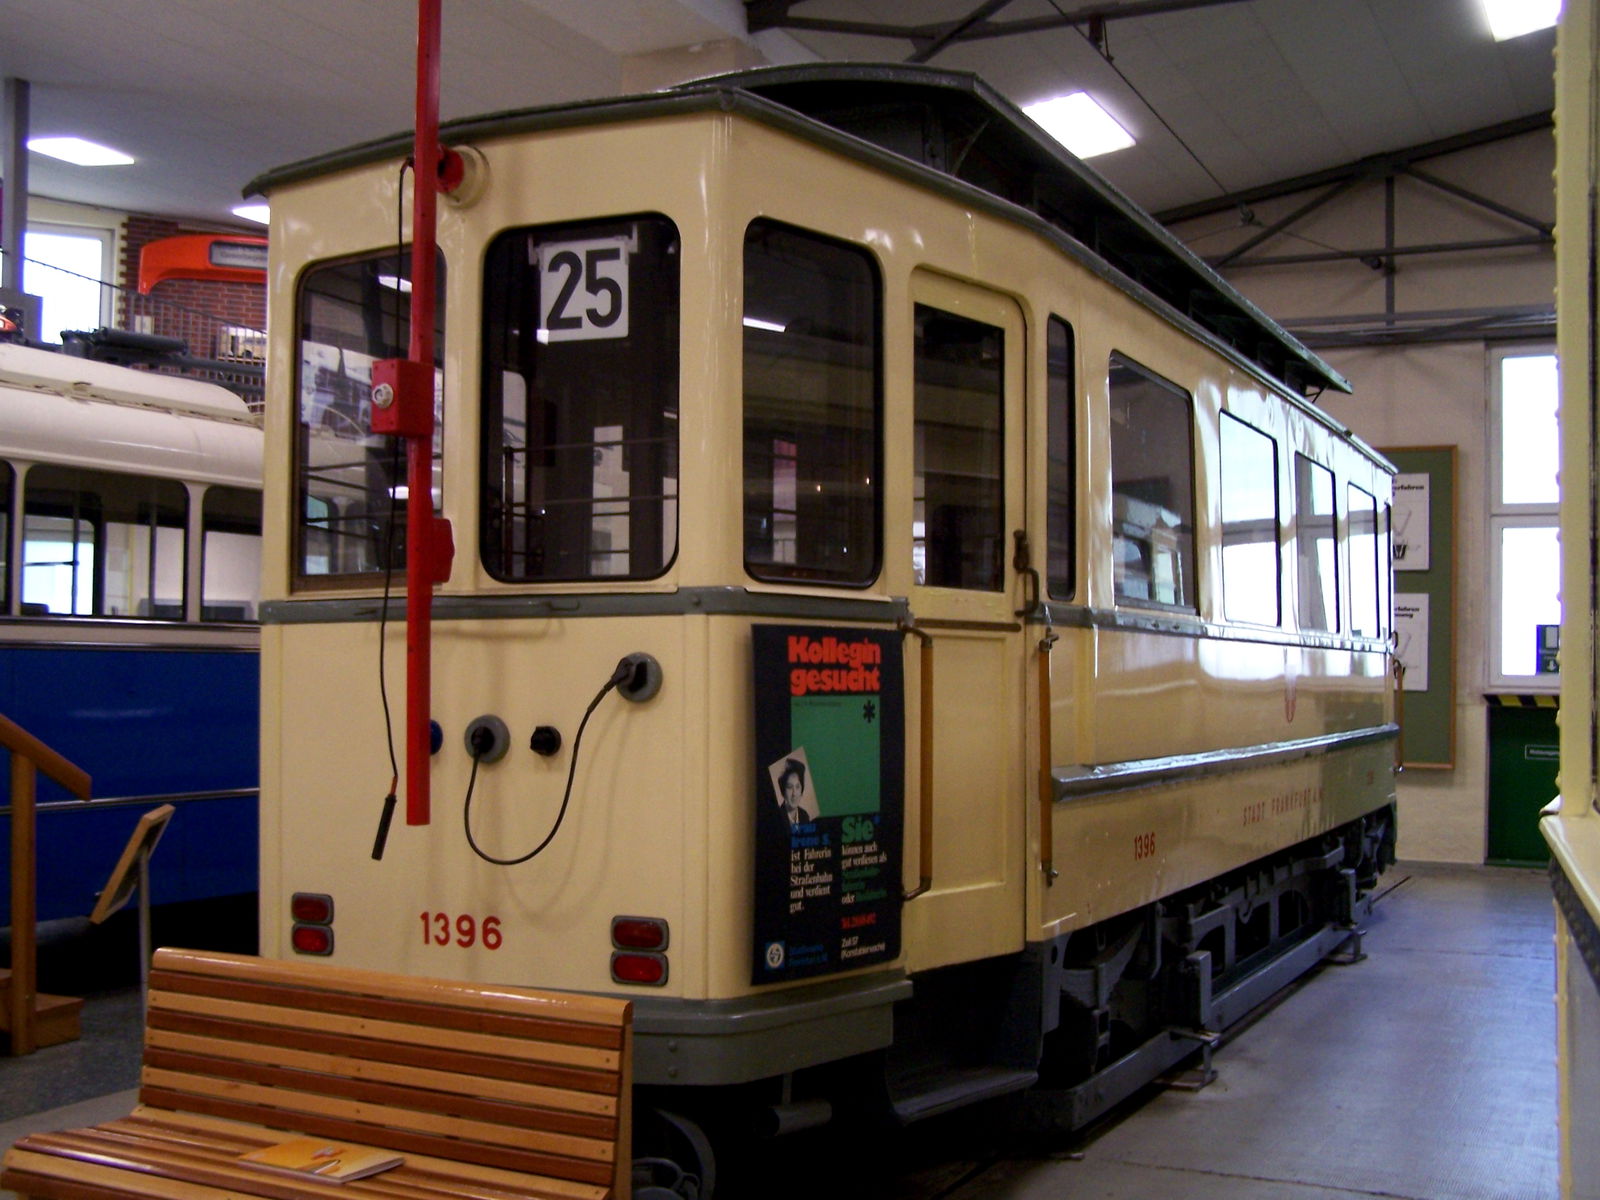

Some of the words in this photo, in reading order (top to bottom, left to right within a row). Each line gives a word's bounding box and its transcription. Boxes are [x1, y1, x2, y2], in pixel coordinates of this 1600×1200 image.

[546, 247, 623, 331] 25
[787, 635, 881, 668] Kollegin
[790, 666, 881, 696] gesucht
[841, 816, 875, 843] Sie
[791, 850, 801, 861] ist
[1134, 831, 1156, 862] 1396
[791, 862, 801, 873] bei
[803, 860, 815, 873] der
[790, 888, 804, 899] und
[805, 884, 831, 898] verdient
[420, 909, 504, 952] 1396
